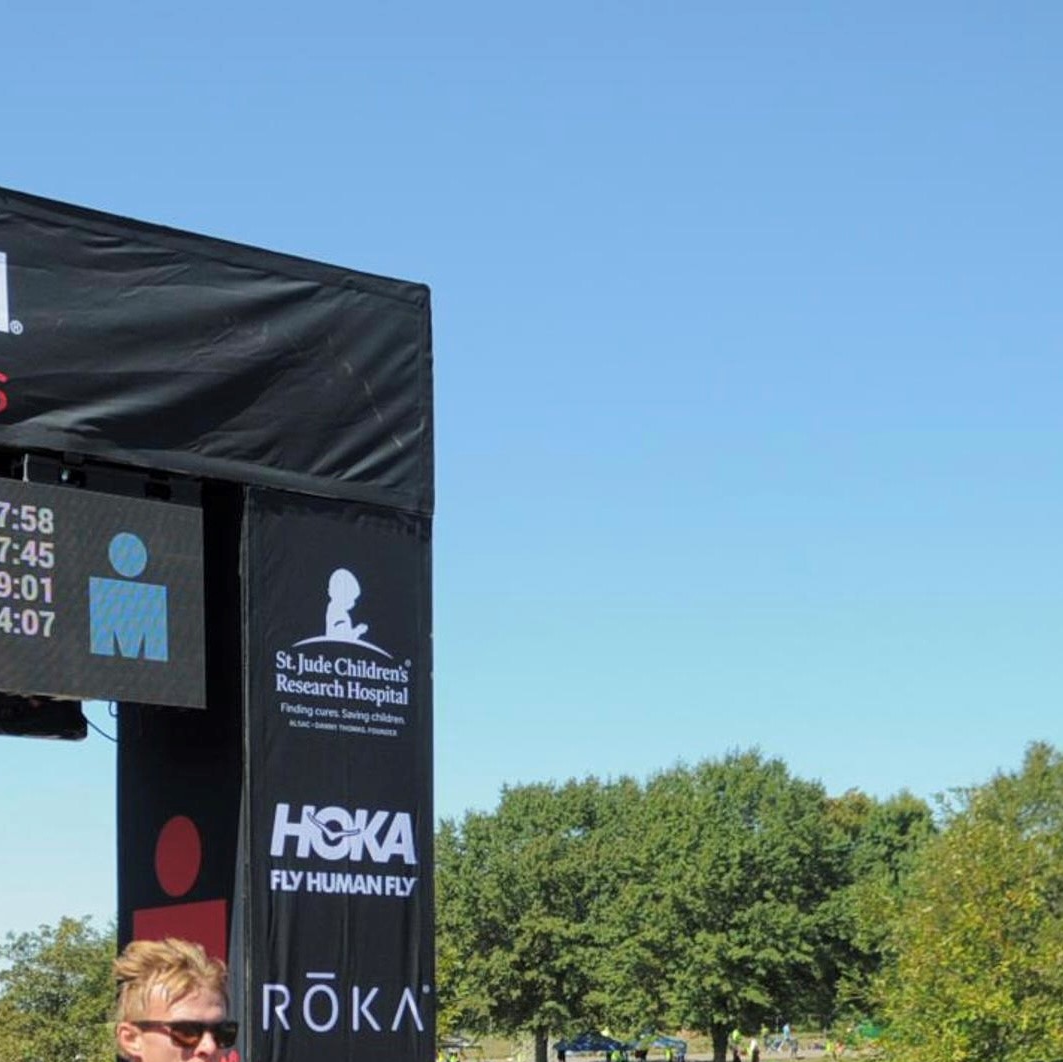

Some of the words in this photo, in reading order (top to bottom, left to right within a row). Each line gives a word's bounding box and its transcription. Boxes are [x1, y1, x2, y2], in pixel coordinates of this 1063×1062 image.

[275, 650, 296, 671] St.
[296, 652, 332, 676] Jude
[334, 657, 410, 683] Children's
[275, 673, 344, 699] Research
[347, 680, 409, 708] Hospital
[280, 702, 314, 718] Finding
[314, 706, 339, 719] cures.
[341, 708, 370, 723] Saving
[371, 711, 406, 726] children.
[270, 803, 417, 864] HOKA
[270, 869, 303, 892] FLY
[306, 872, 382, 896] HUMAN
[385, 876, 418, 896] FLY
